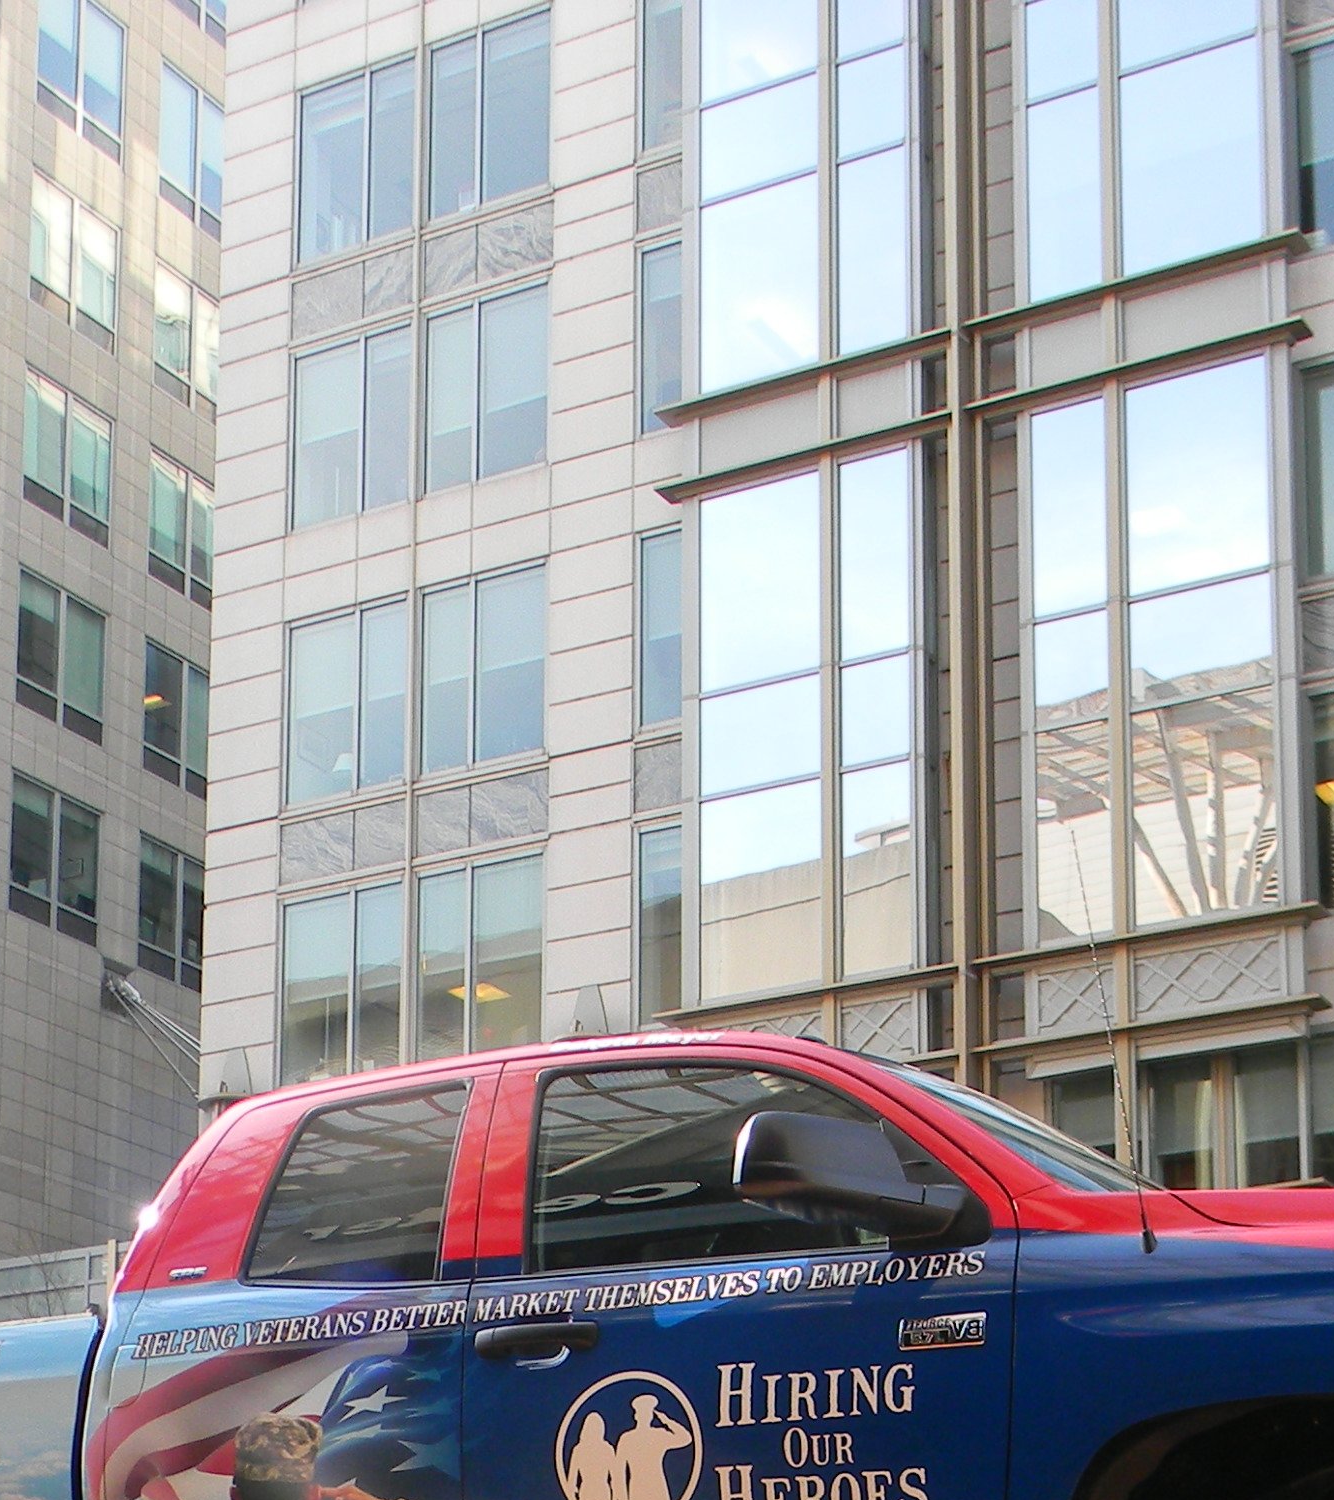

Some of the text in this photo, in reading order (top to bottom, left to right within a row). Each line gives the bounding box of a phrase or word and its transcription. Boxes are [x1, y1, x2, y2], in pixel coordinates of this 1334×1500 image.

[132, 1251, 987, 1359] HELPING VETERANS BETTER MARKET THEMSELVES TO EMPLOYERS
[950, 1318, 983, 1340] V8
[715, 1362, 916, 1428] HIRING
[783, 1427, 855, 1469] OUR
